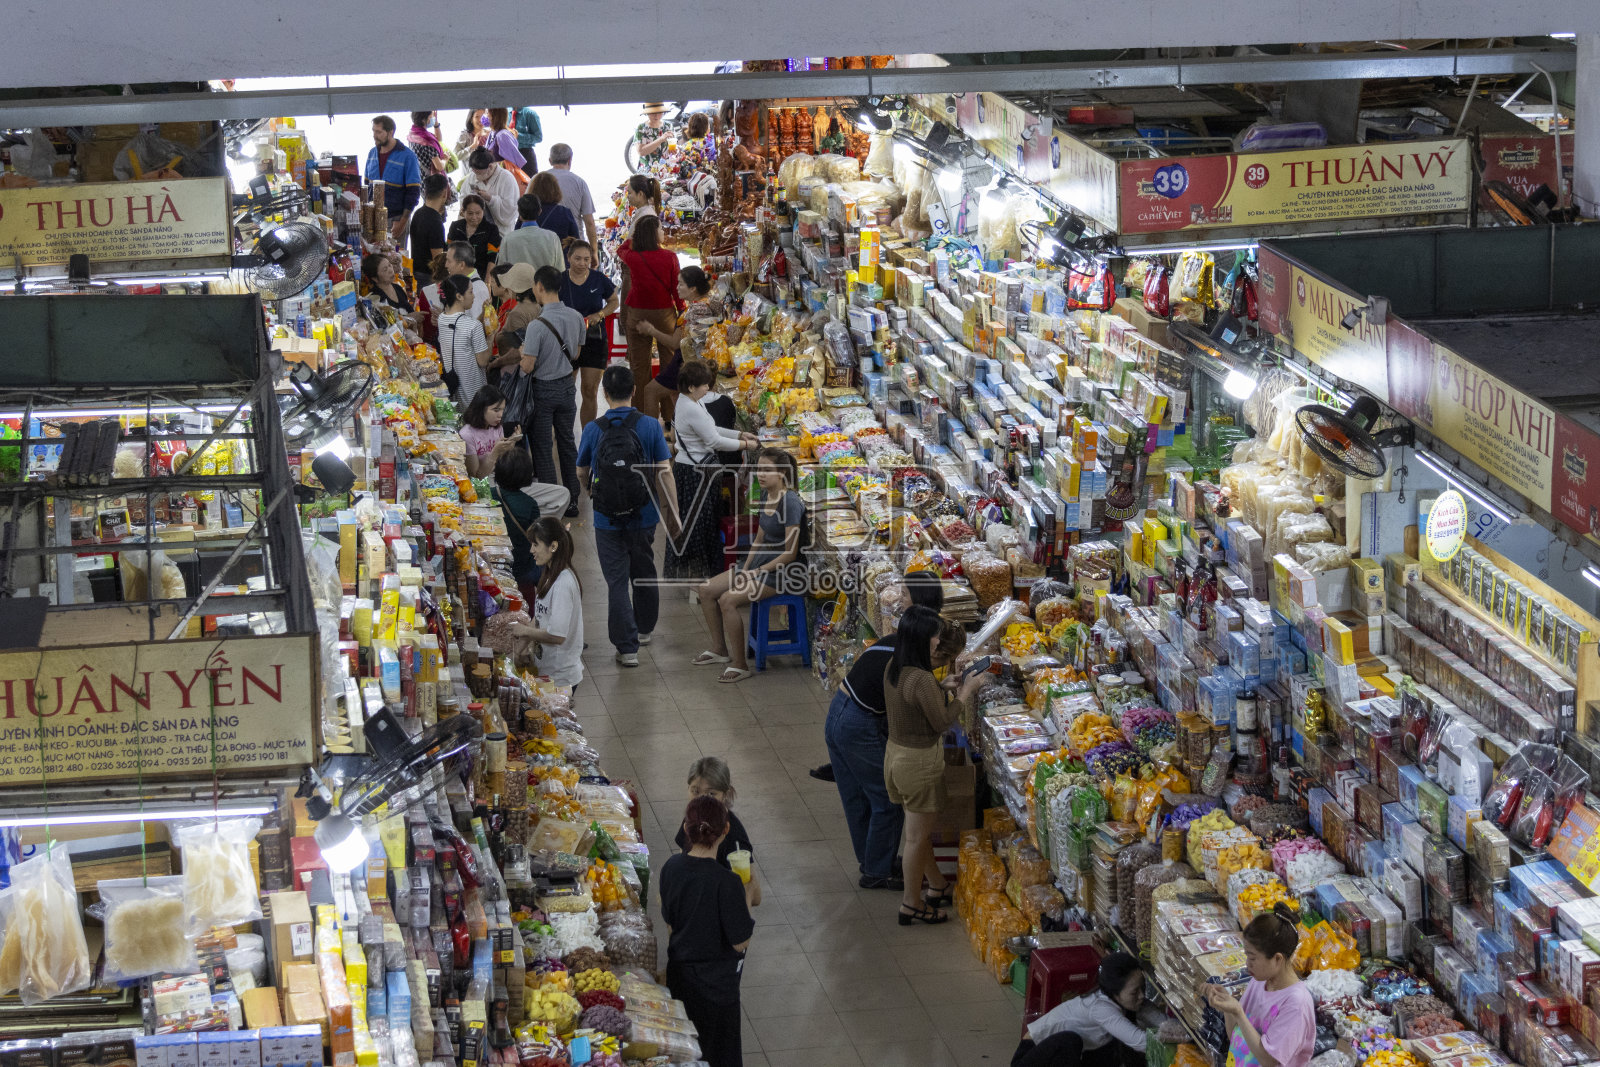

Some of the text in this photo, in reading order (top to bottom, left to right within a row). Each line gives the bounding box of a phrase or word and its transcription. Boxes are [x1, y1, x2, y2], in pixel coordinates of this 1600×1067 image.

[1248, 166, 1265, 181] 39
[1282, 145, 1455, 188] THUẬN VỸ
[1156, 169, 1184, 192] 39
[1507, 176, 1528, 185] VUA
[1326, 189, 1343, 198] KINH
[27, 186, 184, 231] THU HÀ
[1309, 281, 1334, 327] MAI
[1452, 363, 1506, 428] SHOP
[1508, 394, 1552, 459] NHI
[162, 650, 286, 709] YẾN
[34, 726, 64, 739] KINH
[68, 722, 118, 738] DOANH:
[120, 721, 149, 735] ĐẶC
[152, 717, 177, 732] SẢN
[180, 717, 198, 731] ĐÀ
[104, 738, 118, 748] BIA
[14, 754, 34, 764] KHÔ
[19, 766, 42, 776] 0236
[44, 764, 64, 775] 3812
[66, 763, 84, 773] 480
[90, 761, 114, 772] 0236
[115, 760, 138, 770] 3620
[140, 759, 160, 769] 094
[166, 757, 190, 767] 0935
[191, 756, 207, 766] 261
[233, 753, 257, 763] 0935
[259, 752, 275, 762] 190
[276, 751, 289, 761] 181
